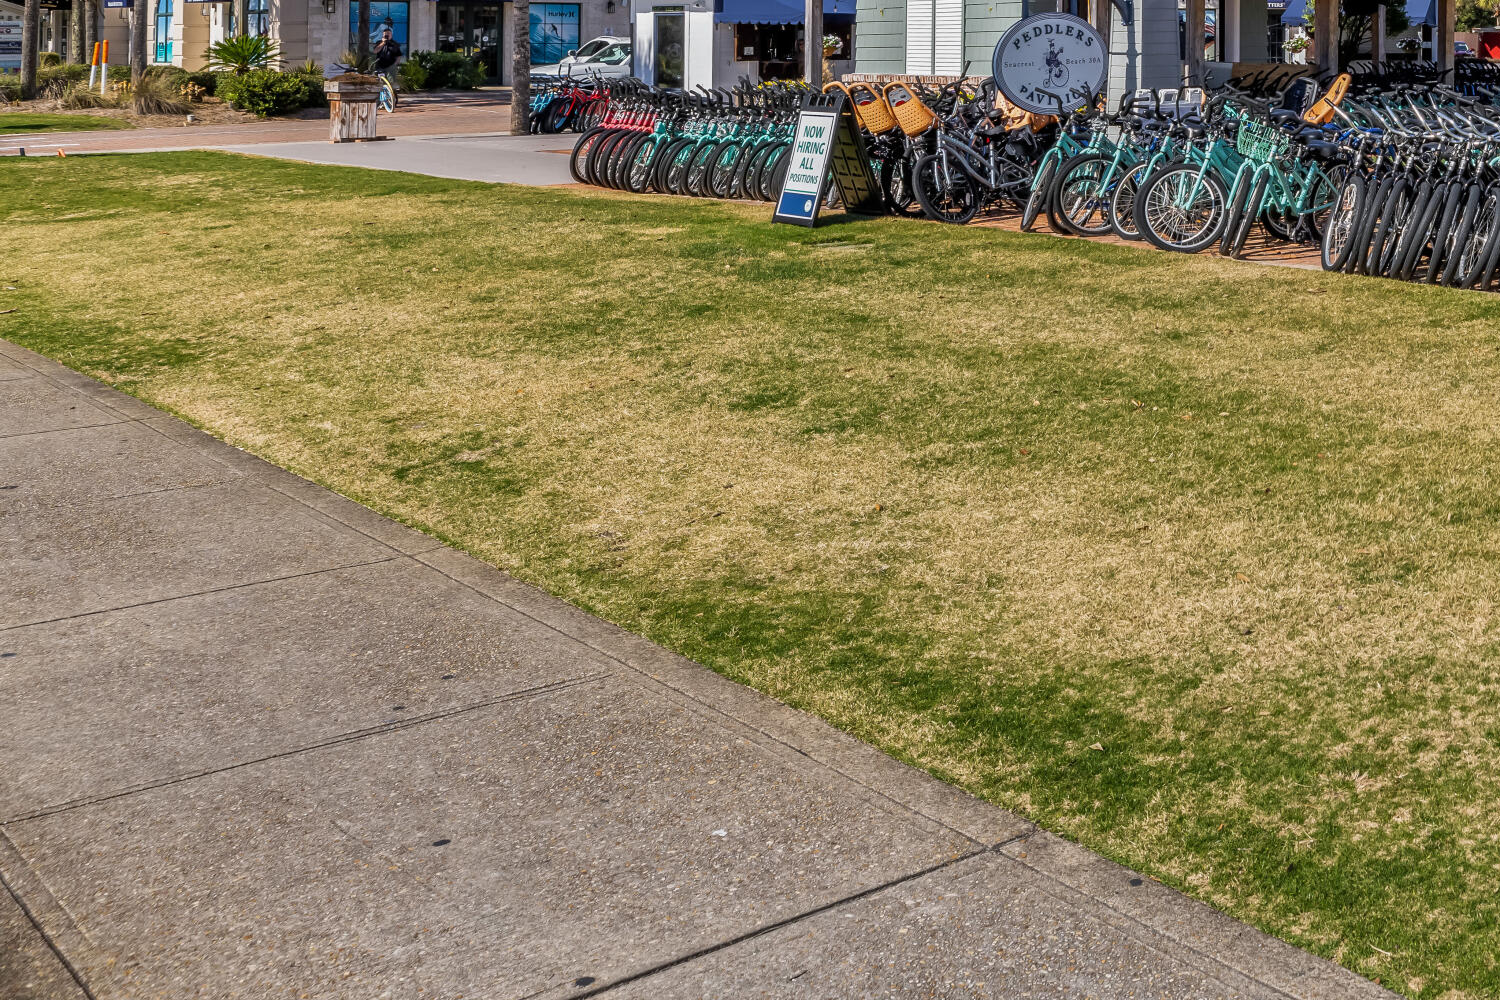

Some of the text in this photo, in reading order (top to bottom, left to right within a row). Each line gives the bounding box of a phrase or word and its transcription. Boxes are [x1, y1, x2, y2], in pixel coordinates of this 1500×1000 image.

[1013, 24, 1094, 50] PEDDLERS
[1020, 81, 1091, 106] PAVIION
[803, 125, 825, 139] NOW
[796, 141, 826, 155] HIRING
[799, 157, 814, 170] ALL
[789, 173, 819, 185] POSITIONS
